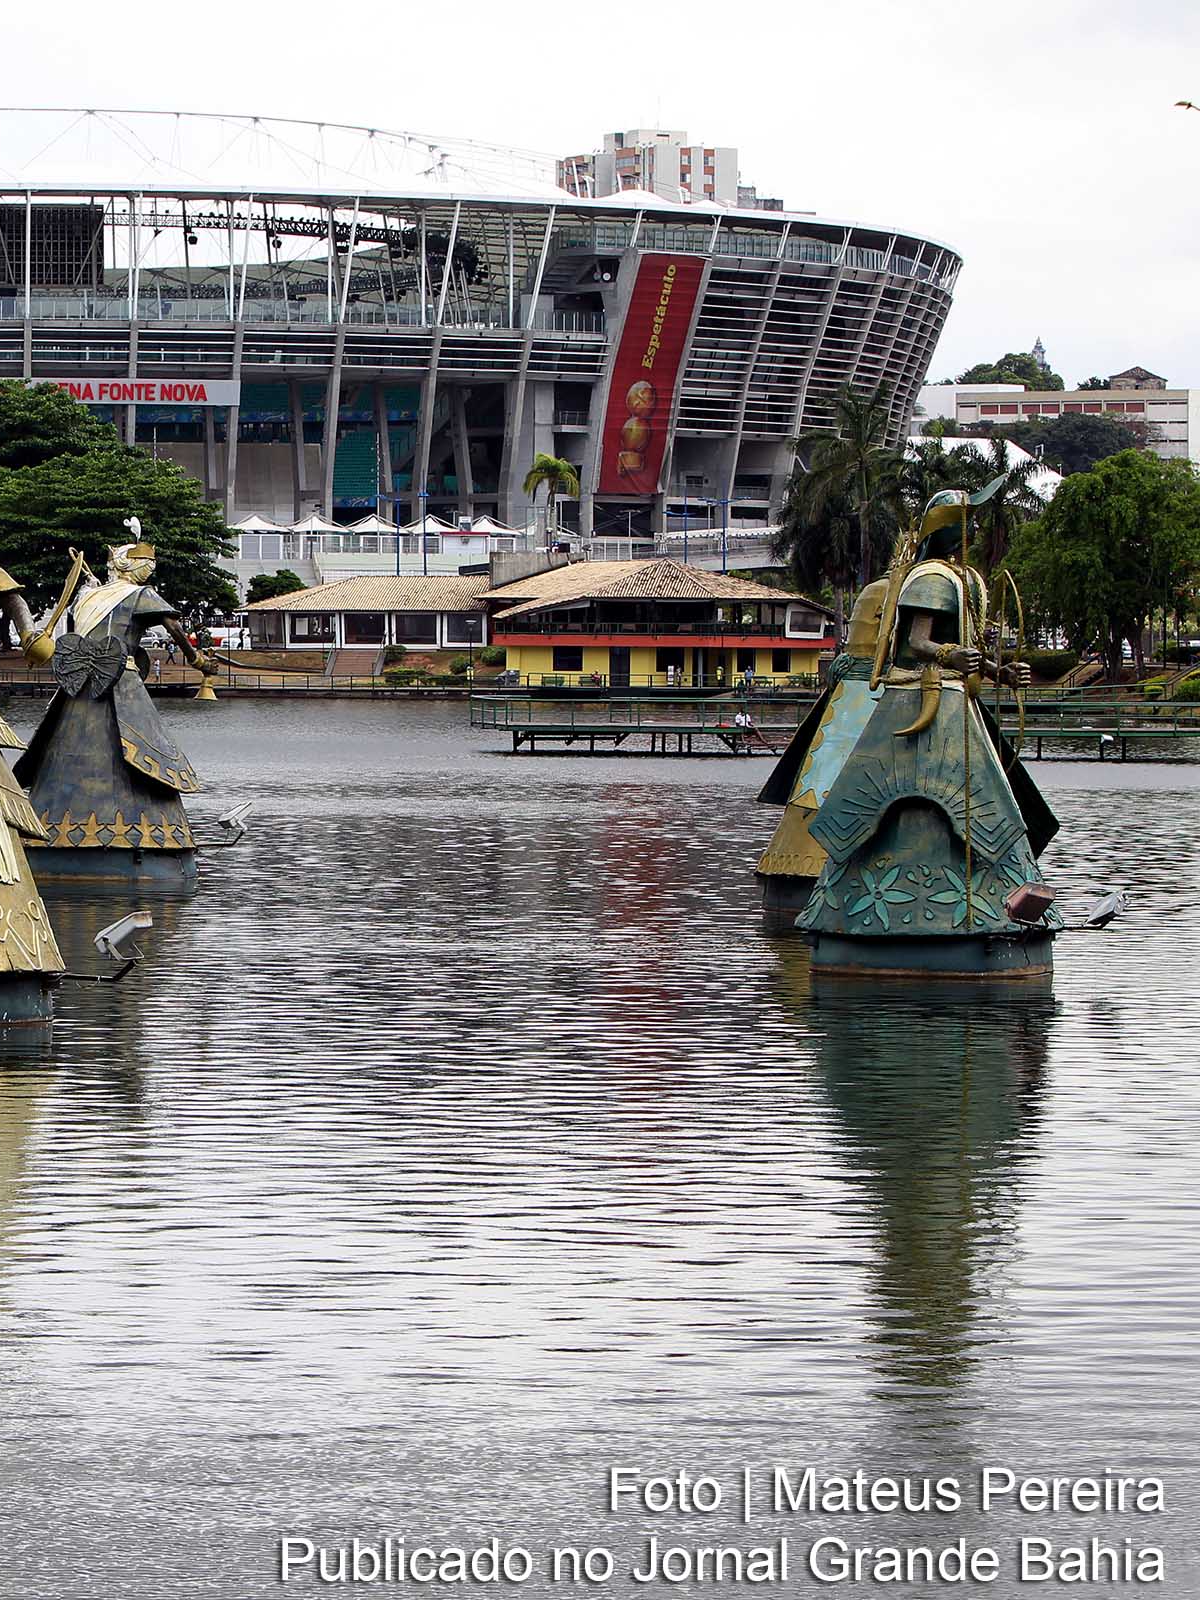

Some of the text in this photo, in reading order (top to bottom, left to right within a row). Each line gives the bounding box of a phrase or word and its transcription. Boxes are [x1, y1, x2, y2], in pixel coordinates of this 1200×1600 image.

[641, 264, 677, 369] Espetáculo
[98, 383, 156, 401] FONTE
[160, 383, 207, 401] NOVA
